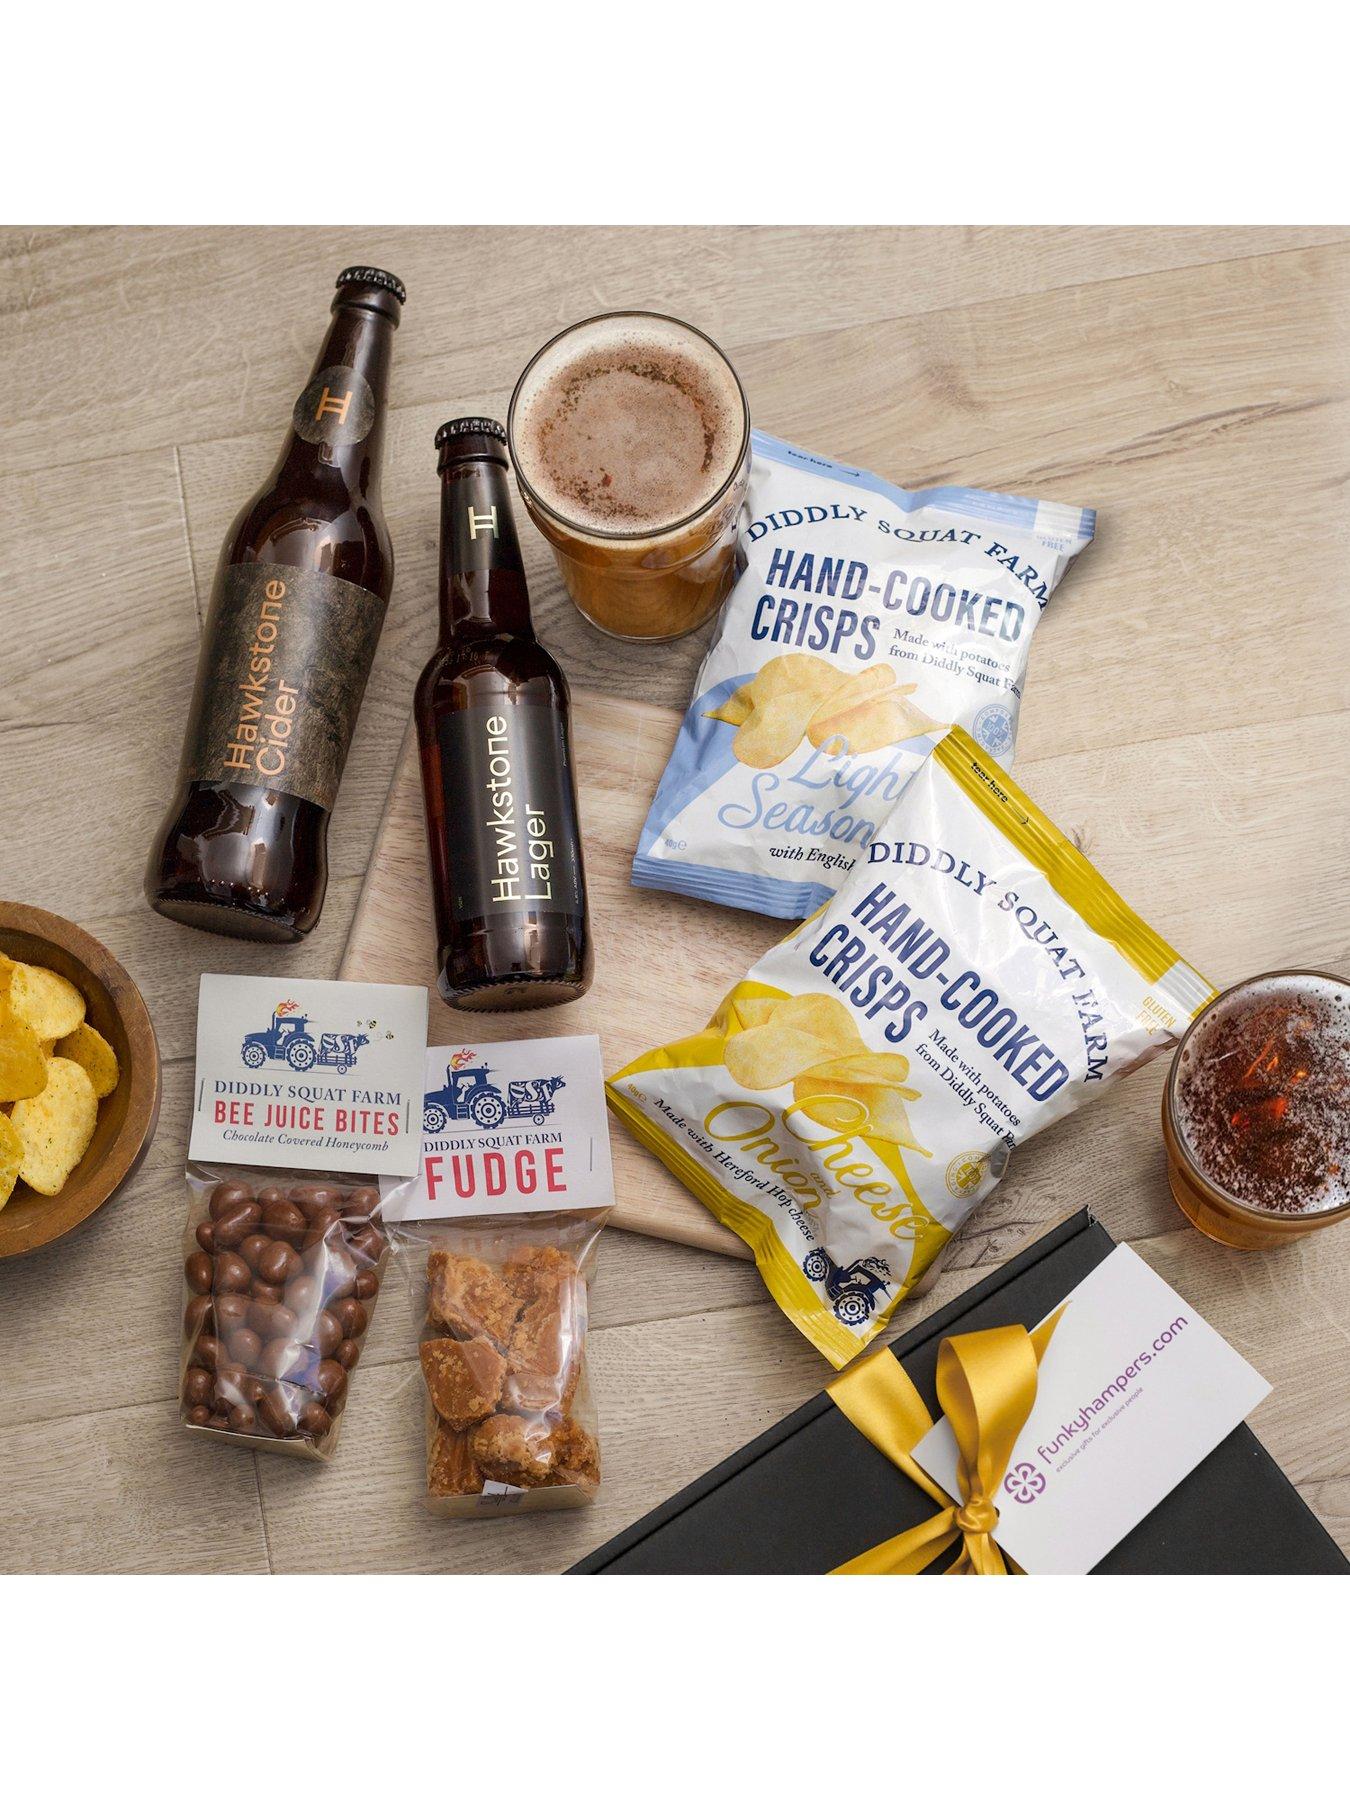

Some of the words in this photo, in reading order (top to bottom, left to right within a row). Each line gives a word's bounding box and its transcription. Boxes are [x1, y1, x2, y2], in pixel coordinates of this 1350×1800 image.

[745, 504, 868, 543] DIDDLY
[877, 520, 982, 546] SQUAT
[984, 541, 1049, 612] FARM
[765, 548, 1026, 644] HAND-COOKED
[223, 579, 286, 770] Hawkstone
[750, 594, 880, 661] CRISPS
[889, 645, 919, 661] from
[922, 653, 965, 676] Diddly
[966, 665, 1003, 686] Squat
[893, 628, 929, 647] Made
[960, 650, 1011, 672] potatoes
[255, 678, 299, 777] Cider
[788, 734, 916, 813] Ligh
[485, 715, 522, 903] Hawkstone
[971, 762, 990, 782] tear
[987, 780, 1008, 803] here
[524, 803, 554, 901] Lager
[769, 845, 804, 861] with
[809, 923, 928, 1044] CRISPS
[850, 882, 1070, 1102] HAND-COOKED
[868, 841, 996, 897] DIDDLY
[996, 891, 1085, 981] SQUAT
[1072, 988, 1109, 1083] FARM
[1142, 995, 1176, 1028] GLUTEN
[214, 1100, 255, 1126] BEE
[264, 1104, 325, 1131] JUICE
[335, 1109, 400, 1136] BITES
[215, 1080, 284, 1097] DIDDLY
[287, 1085, 346, 1103] SQUAT
[352, 1090, 401, 1106] FARM
[915, 1043, 941, 1072] from
[939, 1067, 976, 1107] Diddly
[973, 1102, 1004, 1136] Squat
[1001, 1130, 1017, 1151] Far
[928, 1028, 959, 1063] Made
[958, 1060, 982, 1086] with
[977, 1084, 1021, 1127] potatoes
[222, 1129, 275, 1144] Chocolate
[278, 1133, 322, 1148] Covered
[324, 1137, 390, 1154] Honeycomb
[424, 1138, 476, 1152] DIDDLY
[478, 1135, 525, 1150] SQUAT
[525, 1132, 563, 1145] FARM
[424, 1147, 567, 1200] FUDGE
[654, 1099, 688, 1129] Made
[687, 1127, 714, 1153] with
[713, 1150, 770, 1190] Hereford
[766, 1185, 793, 1208] Hop
[788, 1208, 815, 1242] cheese
[703, 1101, 822, 1216] Onion
[782, 1094, 931, 1242] Cheese
[810, 1171, 842, 1199] and
[1037, 1315, 1188, 1465] funkyhampers.com
[1091, 1428, 1101, 1438] for
[1101, 1404, 1126, 1429] exclusive
[1125, 1386, 1143, 1407] people
